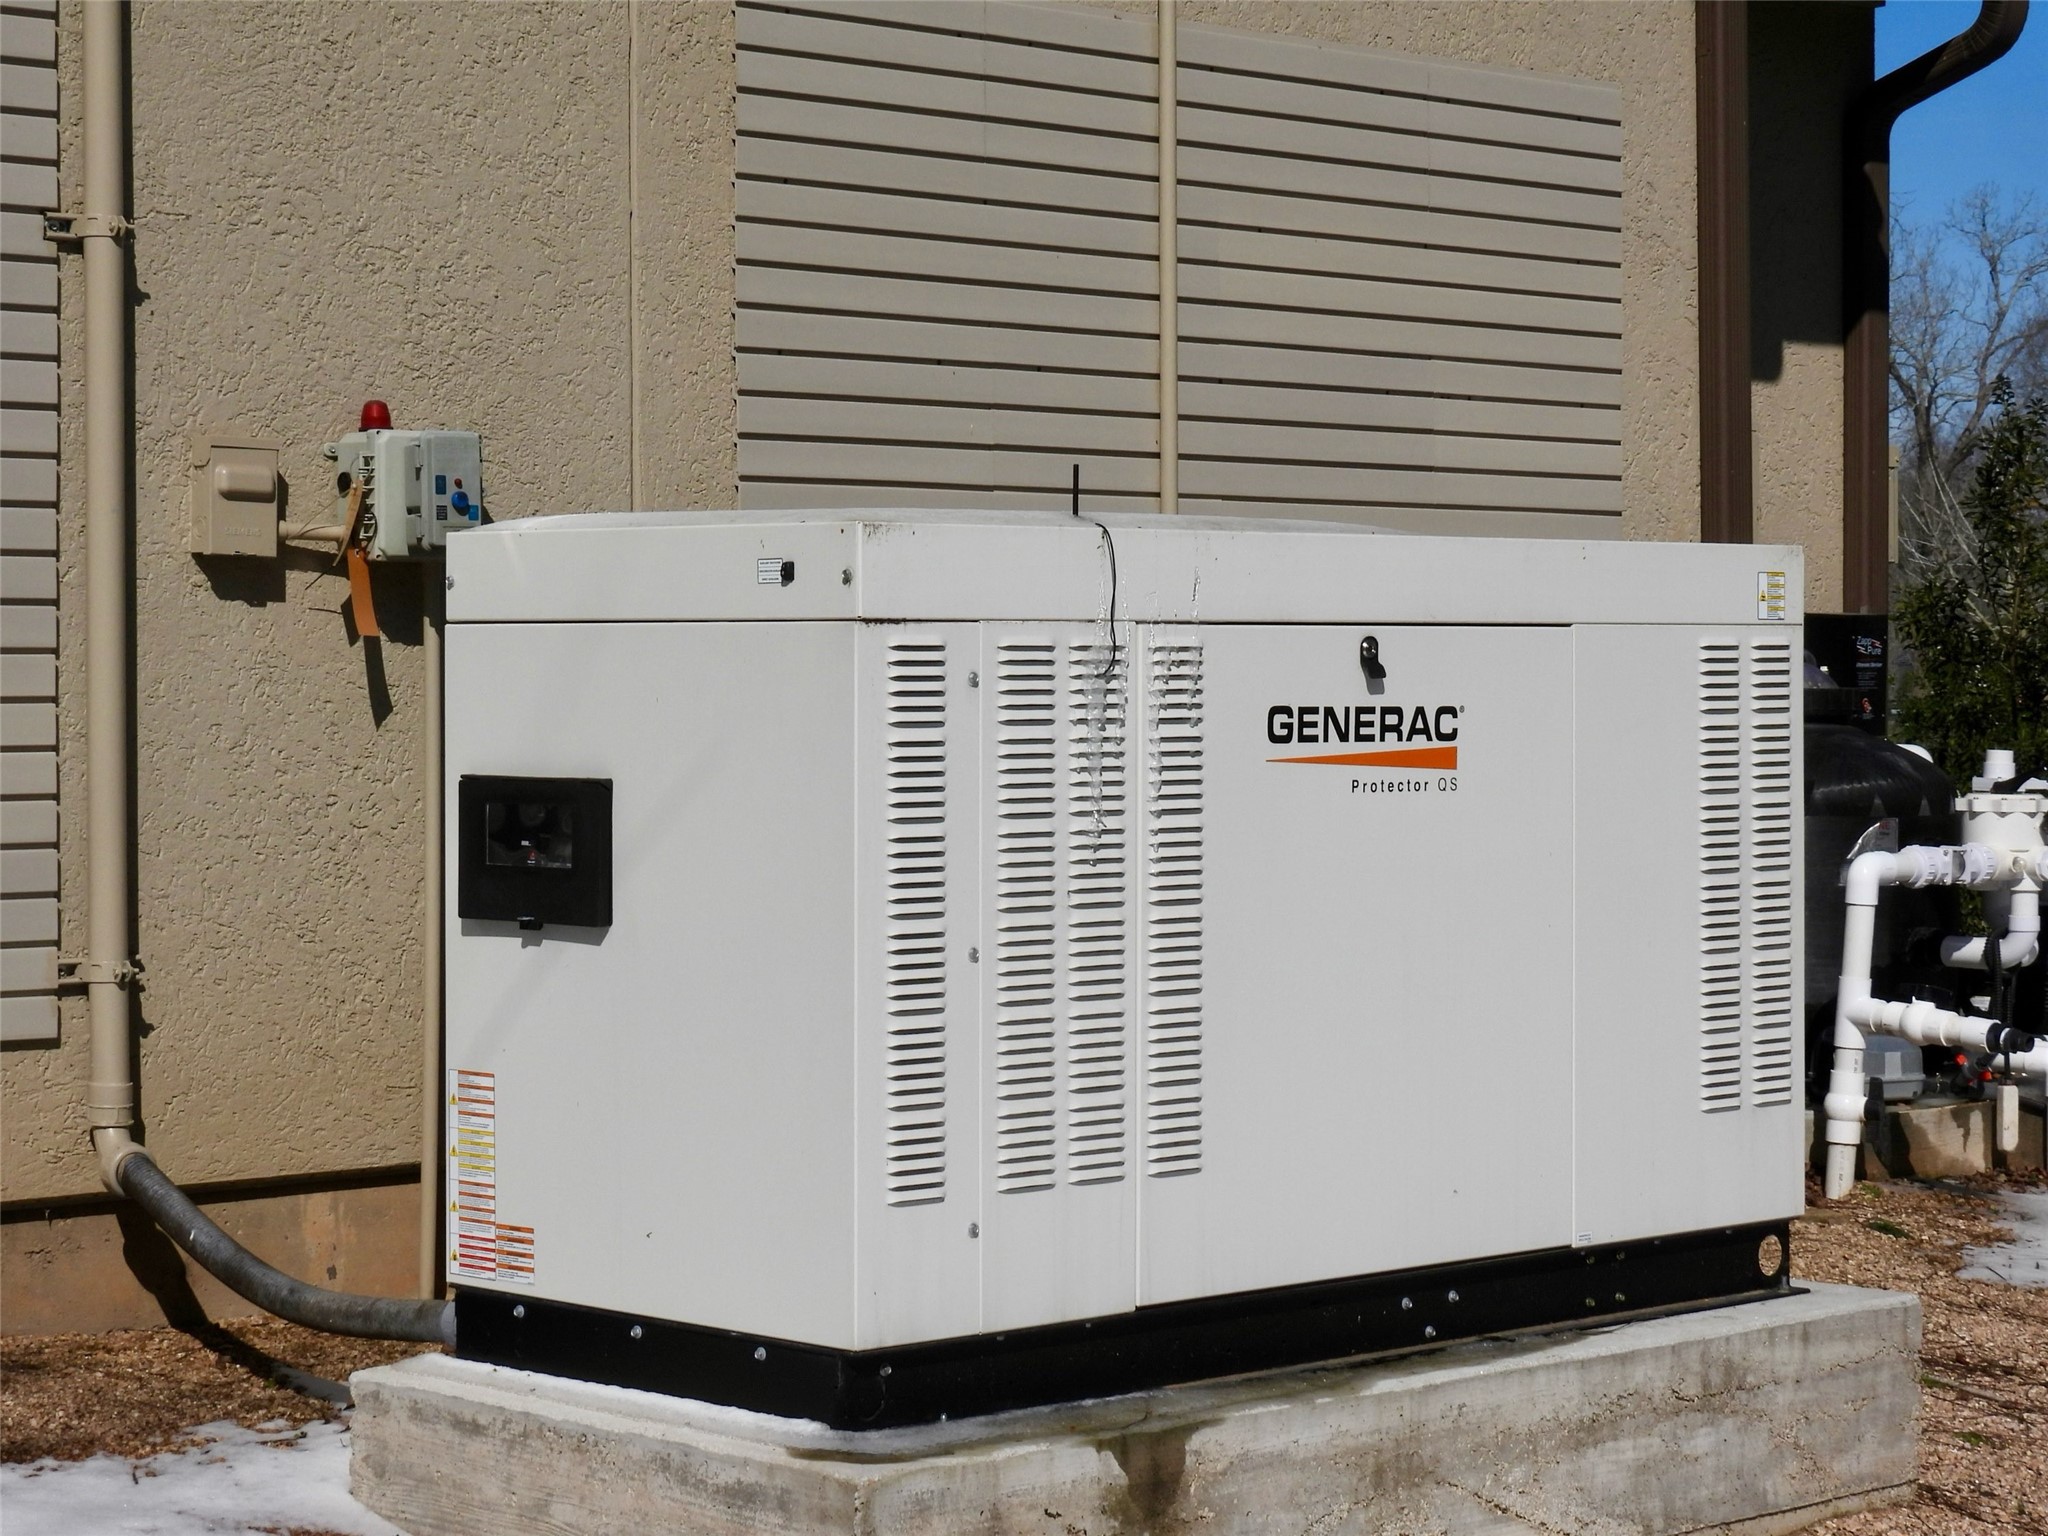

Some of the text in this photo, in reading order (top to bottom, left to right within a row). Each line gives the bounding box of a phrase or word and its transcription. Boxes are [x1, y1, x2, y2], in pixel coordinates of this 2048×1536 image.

[1867, 646, 1882, 655] Pure
[1267, 705, 1459, 744] GENERAC
[1351, 777, 1459, 793] Protector QS
